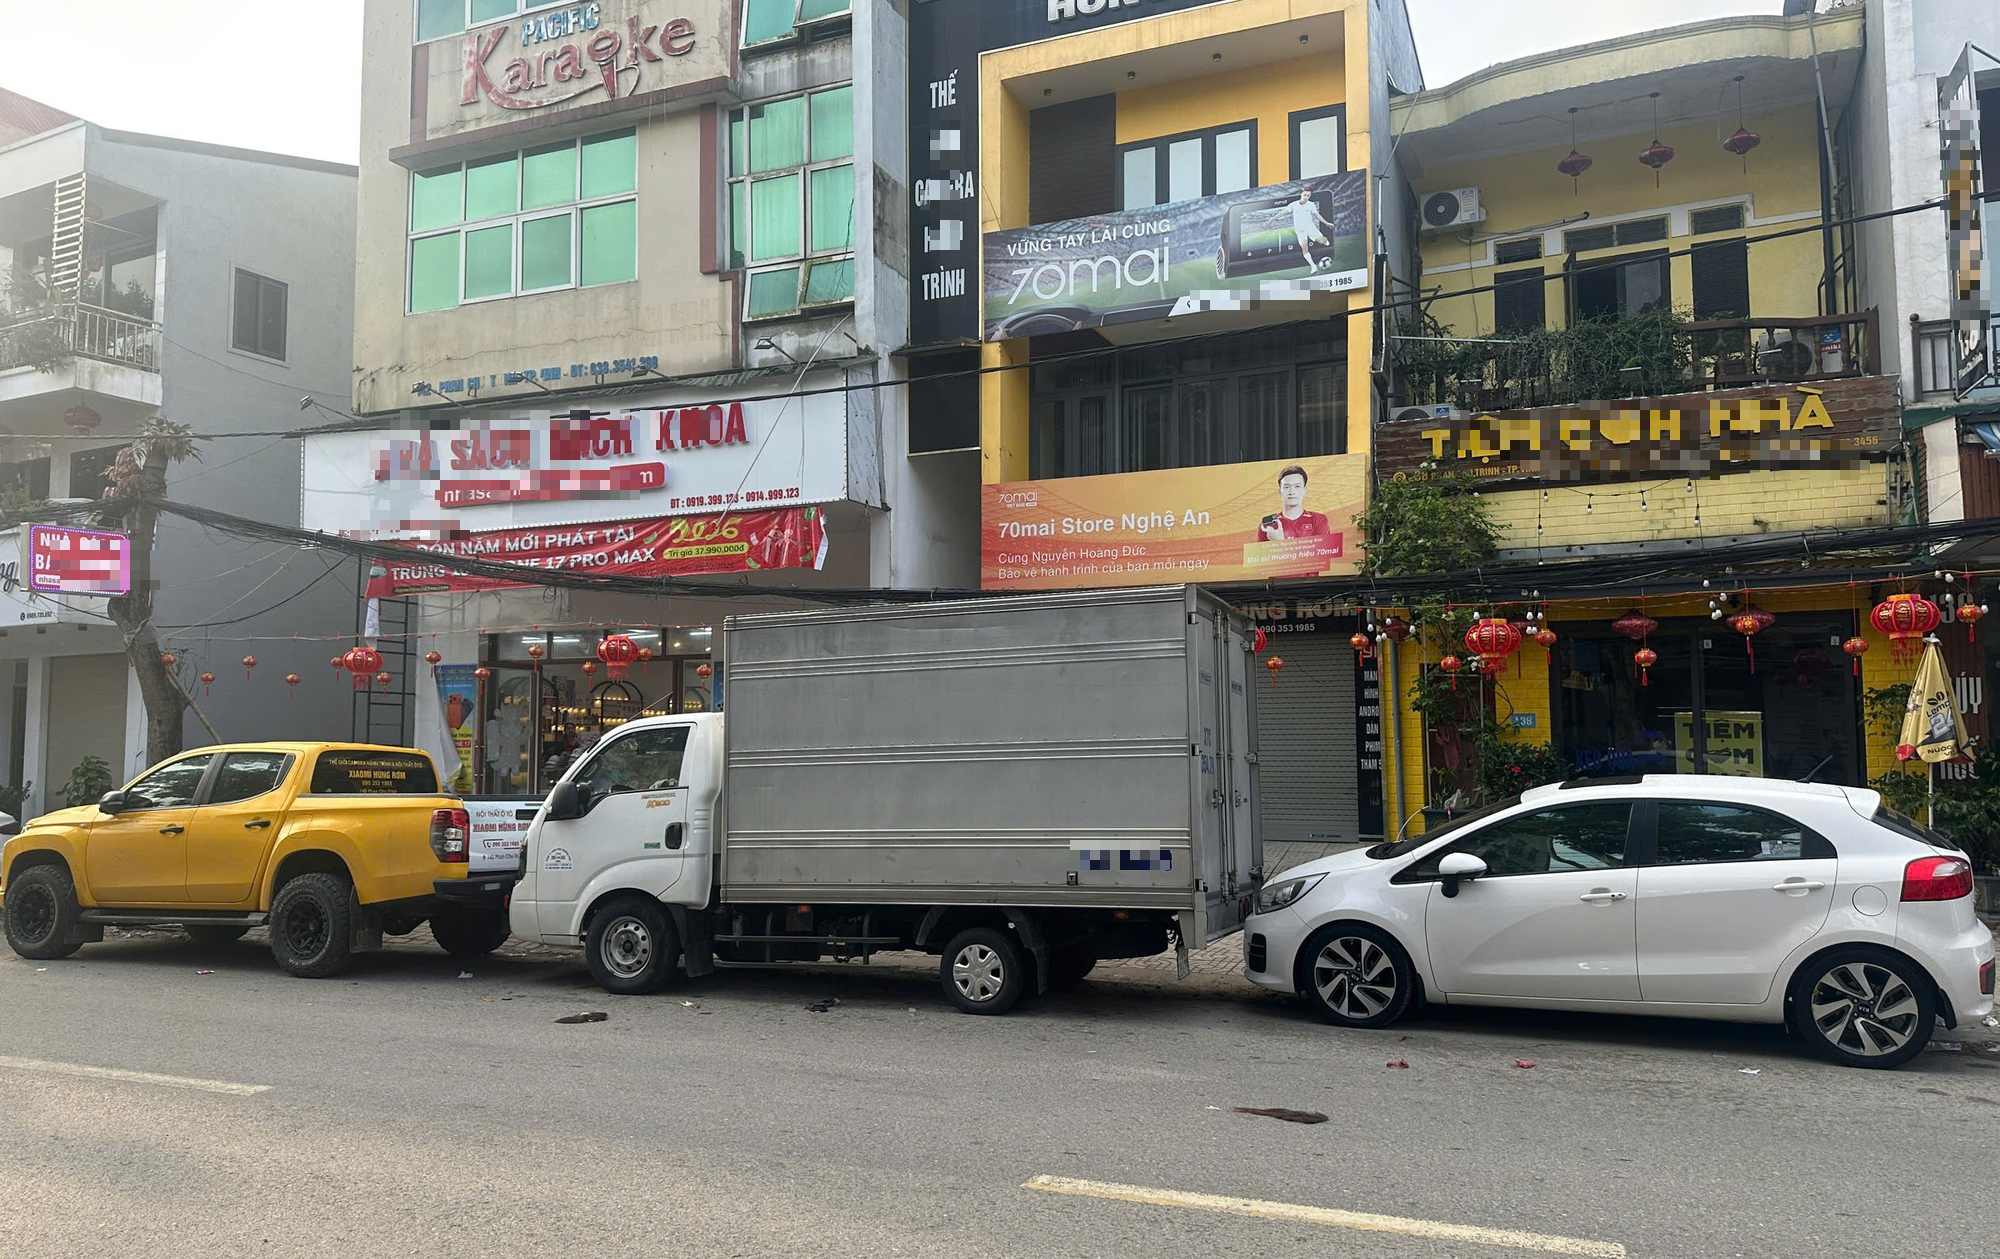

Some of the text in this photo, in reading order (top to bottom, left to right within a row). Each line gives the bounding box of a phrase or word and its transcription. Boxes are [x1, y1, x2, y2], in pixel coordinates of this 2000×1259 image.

[522, 2, 600, 47] PACIFIC
[460, 15, 695, 110] Karaoke
[929, 69, 959, 109] THẾ
[915, 170, 975, 207] CARA
[1007, 219, 1171, 257] VỮNG TAY LÁI CÙNG
[1007, 236, 1170, 305] 70mai
[922, 267, 965, 300] TRÌNH
[1335, 277, 1352, 286] 1985
[439, 379, 464, 393] PHAN
[1854, 436, 1879, 447] 3456
[745, 487, 800, 502] 0914.999.123
[998, 508, 1210, 538] 70mai Store Nghệ An
[461, 537, 500, 556] NĂM
[505, 532, 540, 552] MỚI
[545, 529, 598, 548] PHÁT
[602, 524, 636, 543] TÀI
[570, 551, 610, 568] PRO
[614, 547, 657, 565] MAX
[680, 547, 695, 559] giá
[998, 545, 1147, 565] Cùng Nguyễn Hoàng Đức
[1316, 547, 1339, 556] 70mai
[998, 567, 1021, 579] Bảo
[1041, 565, 1069, 577] hành
[1073, 564, 1098, 576] trình
[1102, 560, 1123, 574] của
[1127, 561, 1149, 574] bạn
[1153, 557, 1175, 570] mỗi
[1180, 557, 1210, 571] ngày
[1259, 623, 1316, 633] 090 353 1985
[348, 770, 372, 779] XIAOMI
[373, 769, 391, 779] HÙNG
[473, 823, 497, 832] XIAOMI
[498, 821, 516, 832] HÙNG
